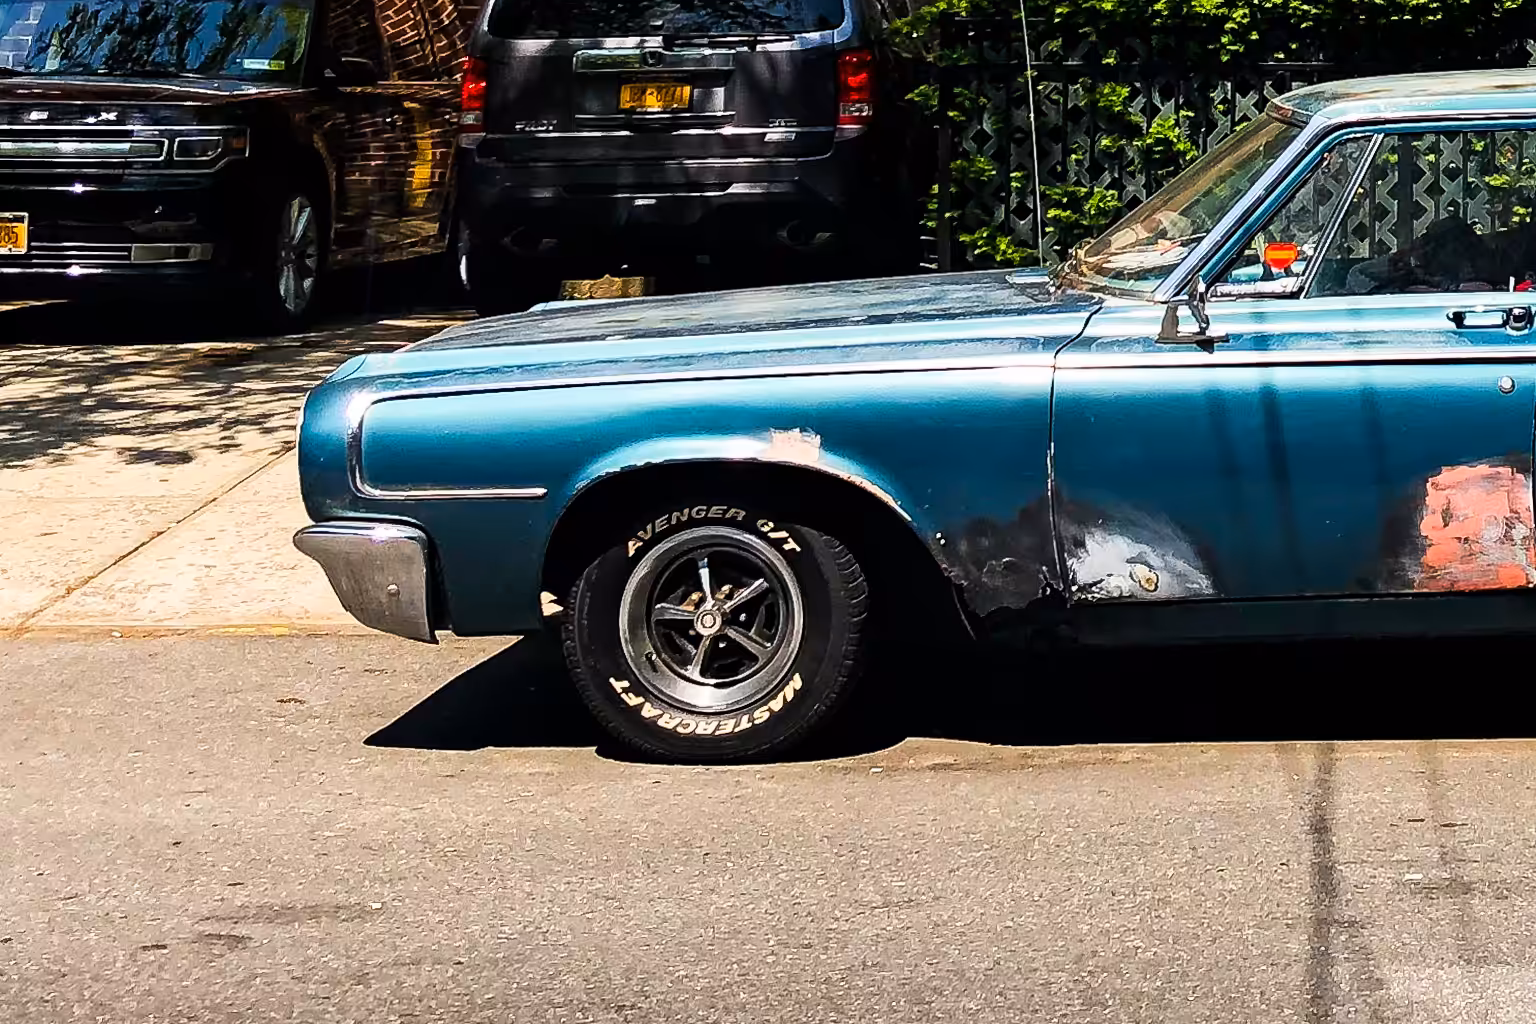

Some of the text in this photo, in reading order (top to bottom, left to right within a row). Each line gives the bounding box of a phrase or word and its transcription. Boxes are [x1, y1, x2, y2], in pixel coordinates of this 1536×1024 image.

[627, 505, 801, 558] AVENGER G/T
[608, 672, 803, 737] MASTERCRAFT
